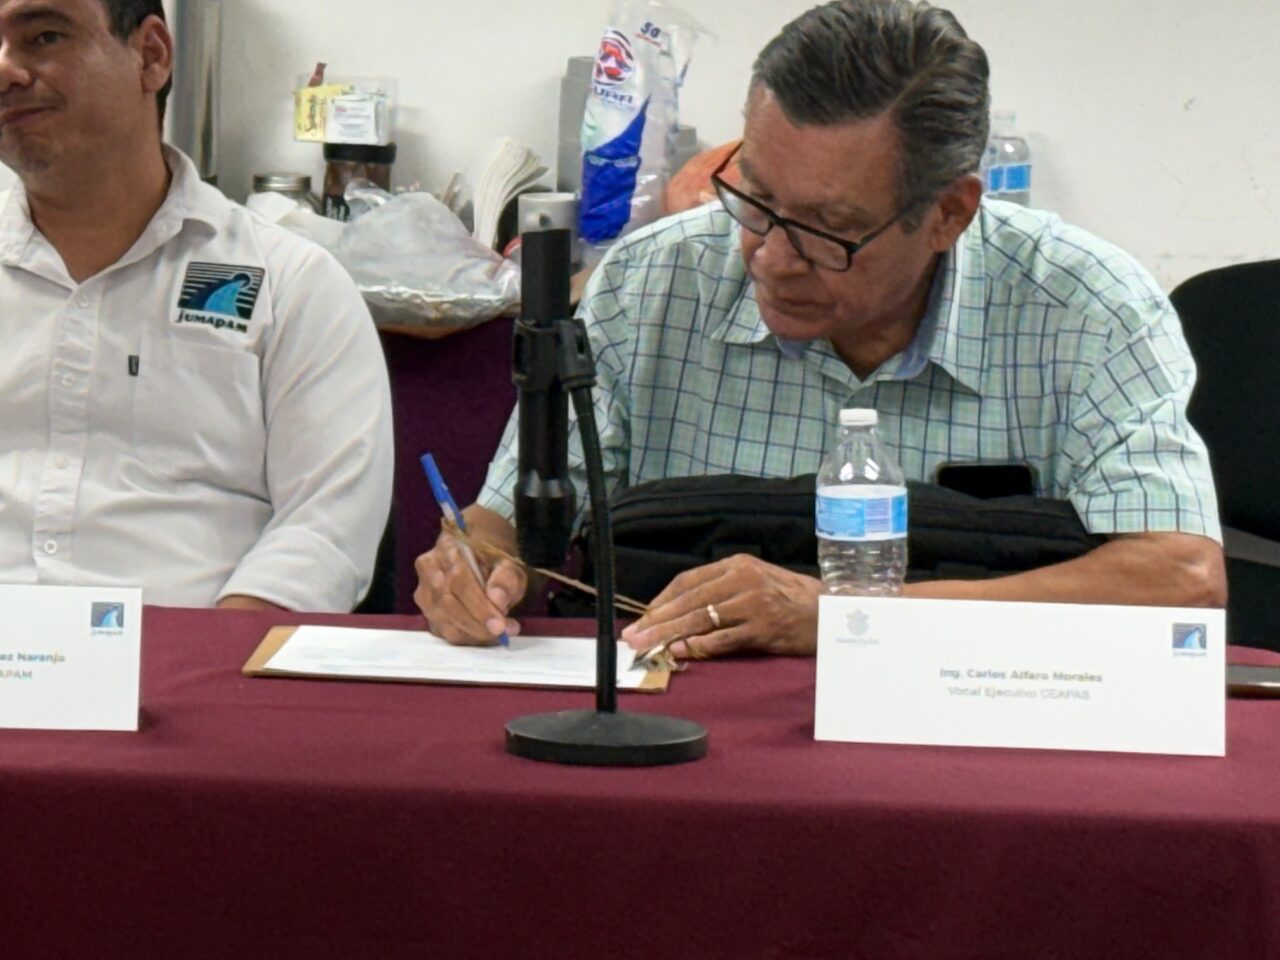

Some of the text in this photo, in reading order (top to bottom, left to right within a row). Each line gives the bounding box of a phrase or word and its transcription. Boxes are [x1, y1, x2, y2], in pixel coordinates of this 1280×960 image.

[17, 652, 66, 664] Naranjo
[967, 668, 1007, 680] Carlos
[1010, 670, 1050, 681] Alfaro
[1052, 672, 1104, 683] Morales
[947, 685, 982, 697] Vocal
[984, 687, 1039, 700] Ejecutivo
